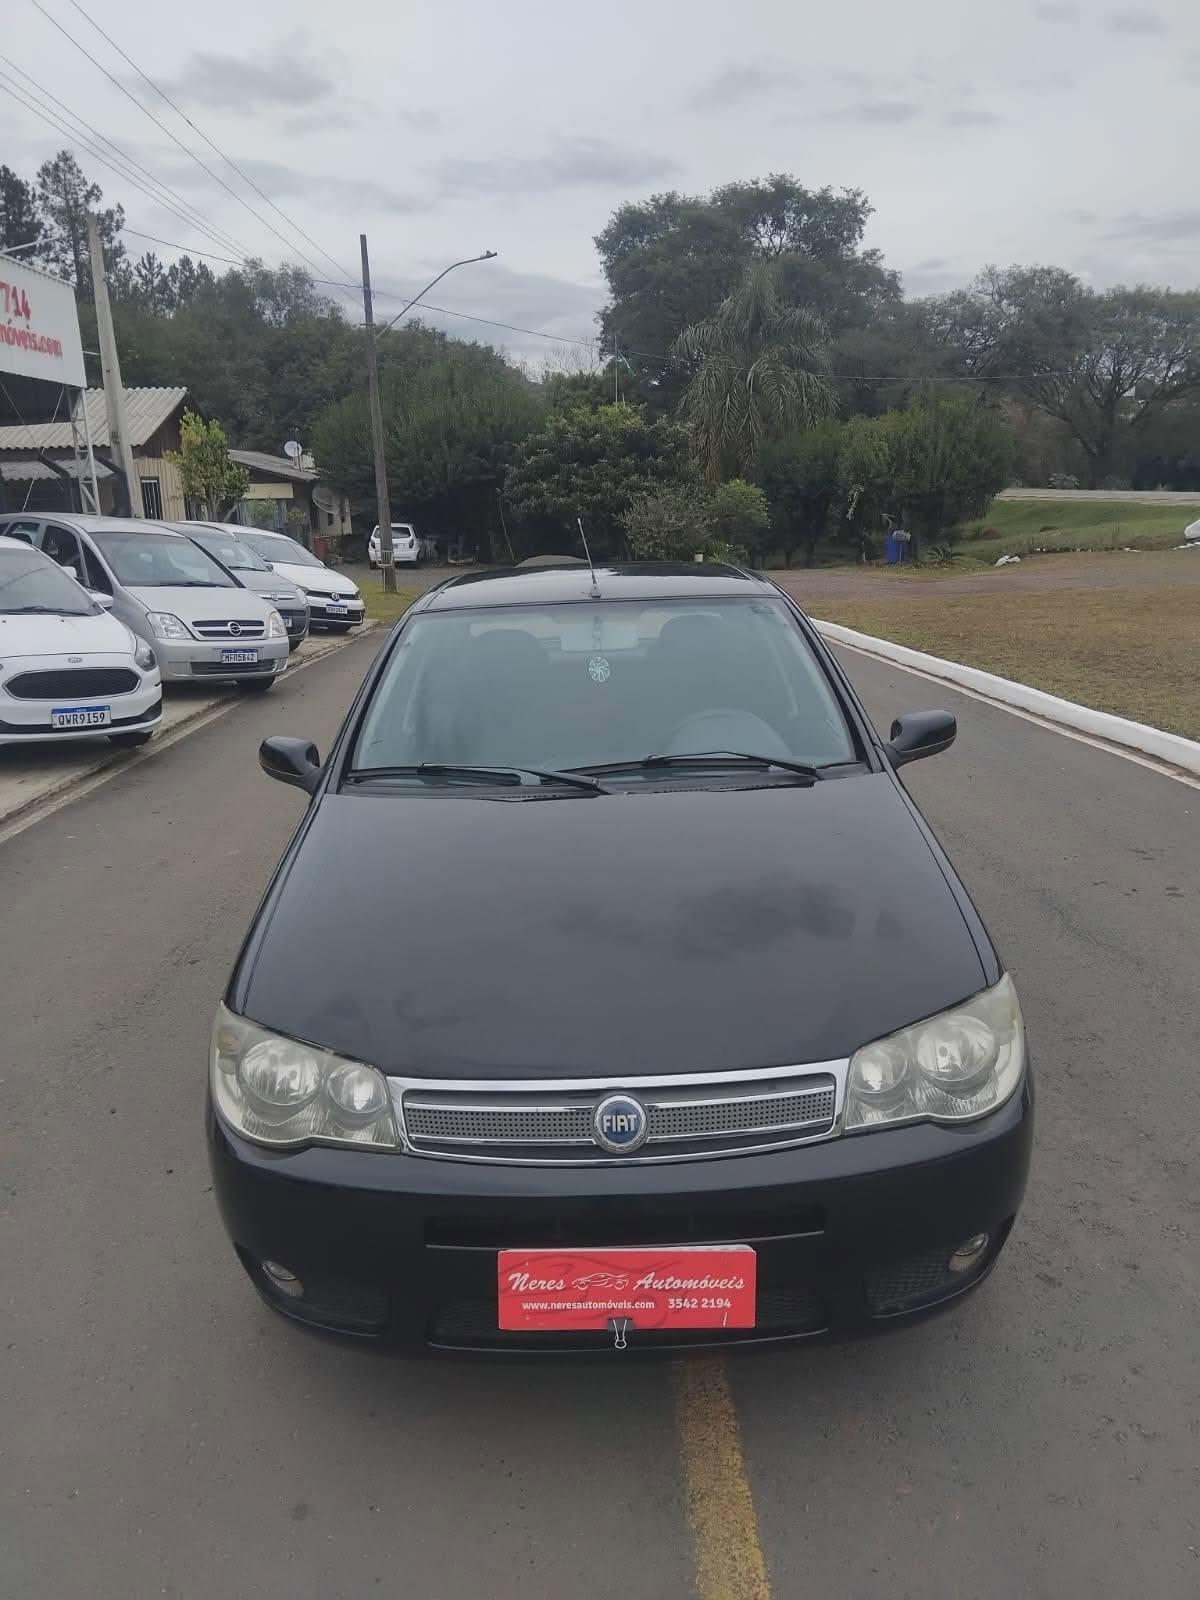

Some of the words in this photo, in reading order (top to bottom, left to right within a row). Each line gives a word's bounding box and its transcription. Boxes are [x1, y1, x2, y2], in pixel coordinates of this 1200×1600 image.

[602, 1114, 637, 1132] FIAT
[508, 1272, 566, 1292] Neres
[632, 1271, 745, 1291] Automóveis
[522, 1300, 655, 1311] www.neresautomóveis.com
[668, 1298, 699, 1309] 3542
[701, 1298, 732, 1309] 2194
